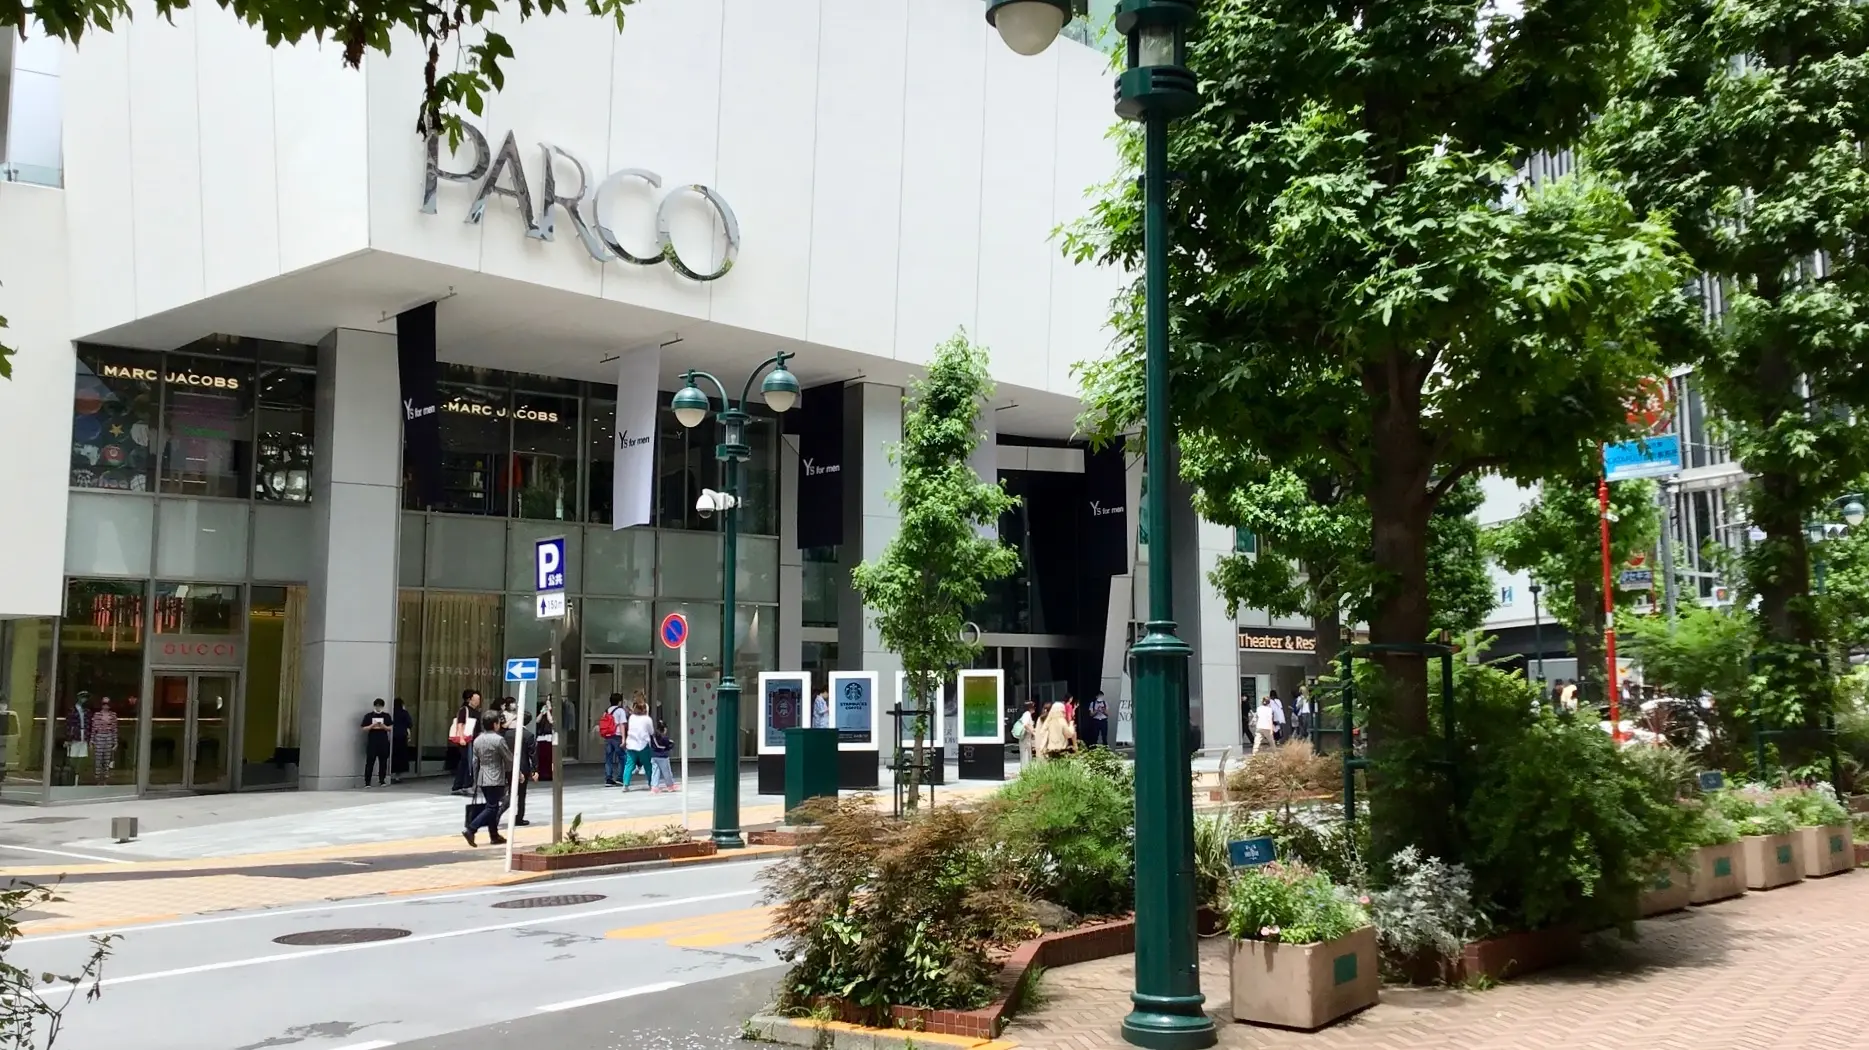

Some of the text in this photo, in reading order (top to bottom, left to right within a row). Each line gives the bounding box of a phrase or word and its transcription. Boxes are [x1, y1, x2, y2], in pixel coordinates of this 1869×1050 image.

[419, 112, 741, 281] PARCO
[104, 365, 239, 390] MARC JACOBS
[448, 402, 492, 416] MARC
[538, 543, 560, 588] P
[547, 572, 563, 586] 公共
[1239, 633, 1317, 650] Theater & Res
